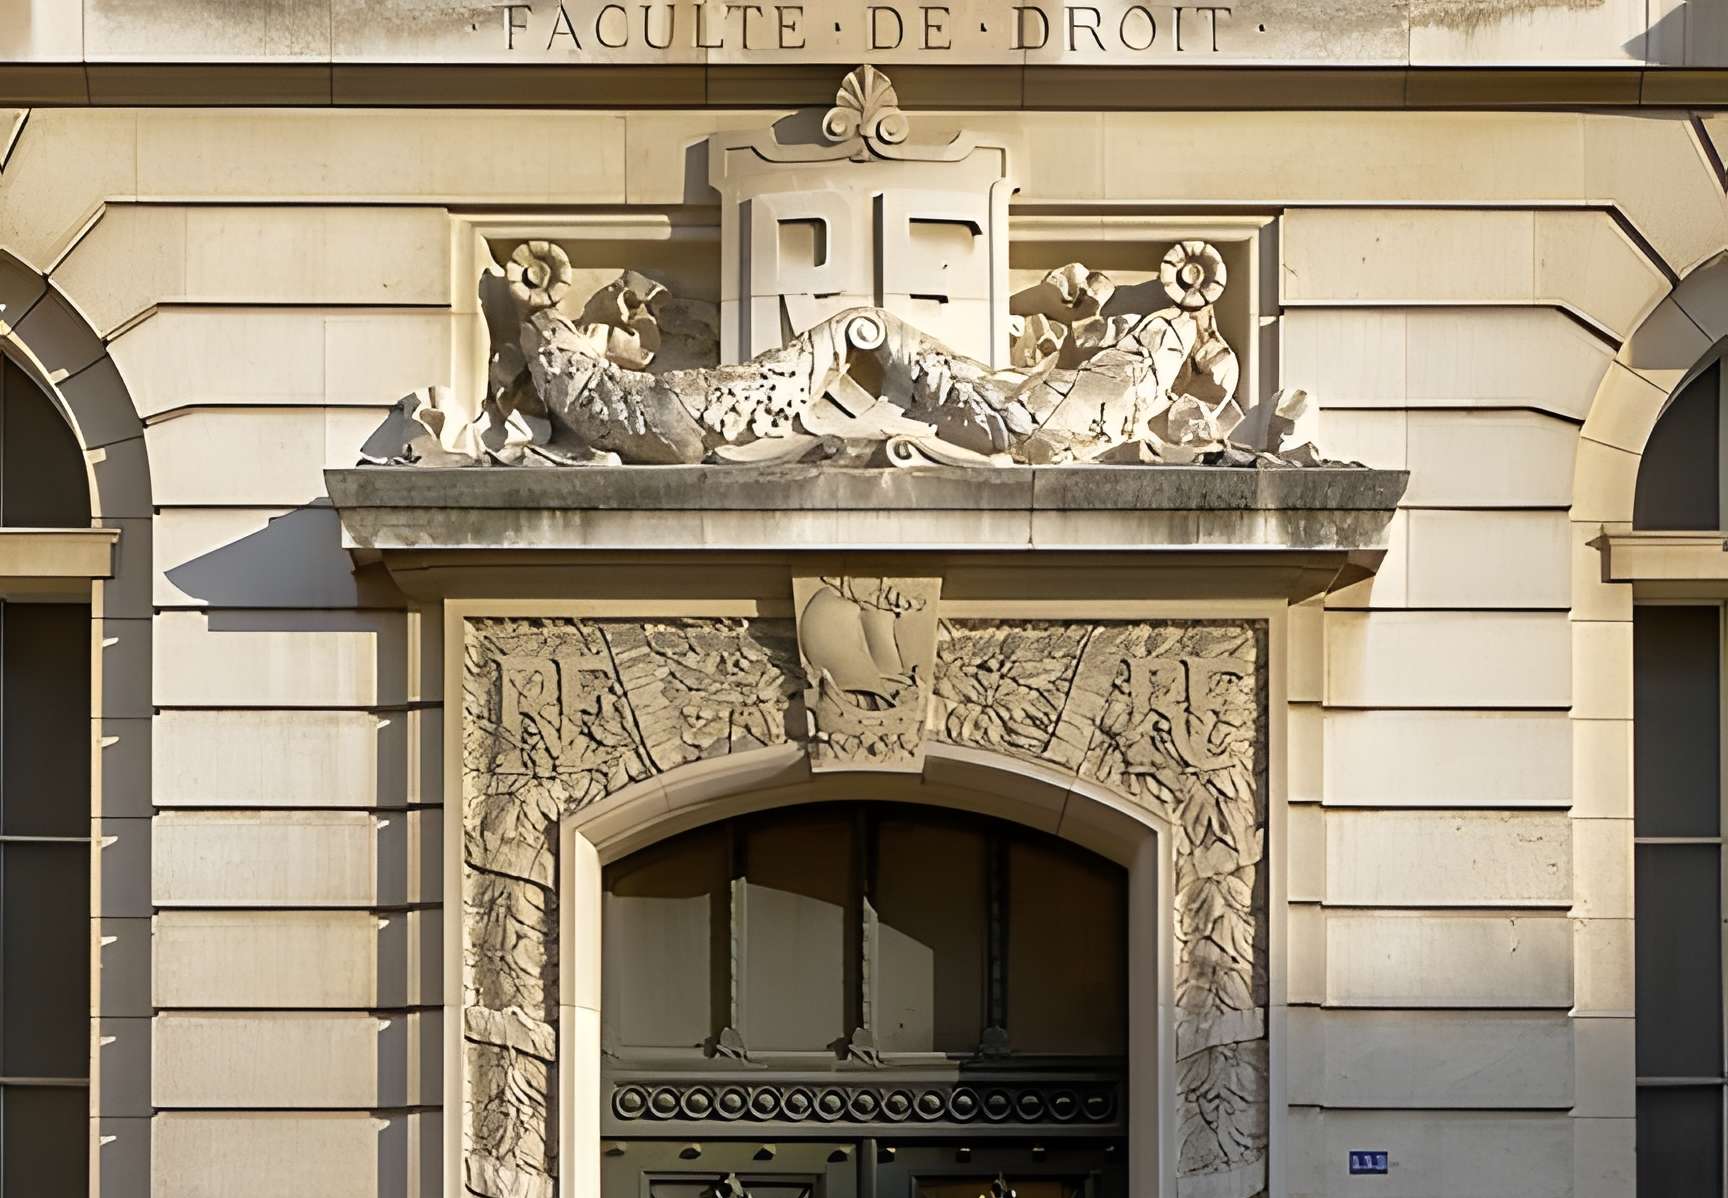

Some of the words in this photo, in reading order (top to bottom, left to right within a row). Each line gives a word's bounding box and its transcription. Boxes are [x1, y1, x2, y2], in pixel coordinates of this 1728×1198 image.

[494, 1, 807, 50] FACULTE
[867, 5, 952, 50] DE
[1008, 5, 1232, 51] DROIT
